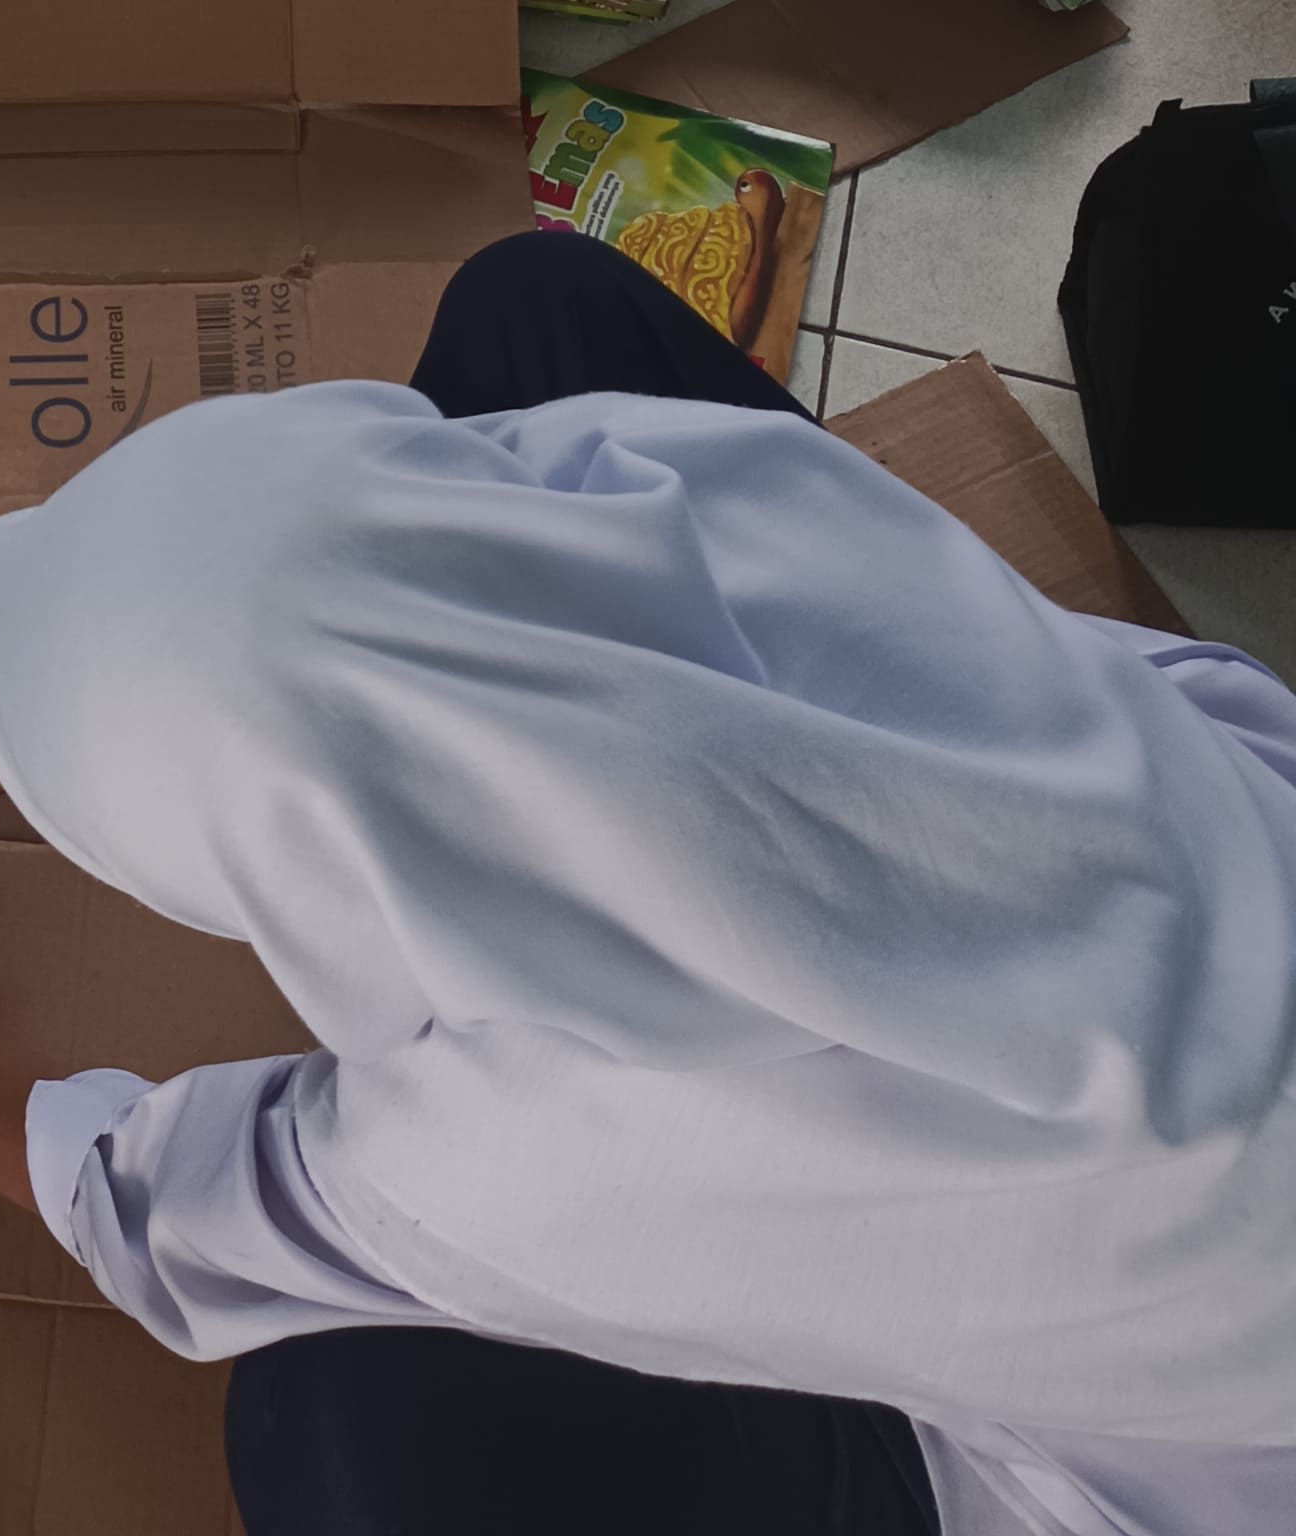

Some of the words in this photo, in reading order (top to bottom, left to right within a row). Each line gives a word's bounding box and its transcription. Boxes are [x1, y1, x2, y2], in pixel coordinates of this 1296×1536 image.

[241, 284, 261, 309] 48
[270, 281, 292, 316] KG
[243, 314, 263, 333] X
[274, 319, 294, 342] 11
[103, 304, 126, 380] mineral
[245, 336, 265, 366] ML
[8, 295, 93, 449] olle
[108, 382, 127, 414] air
